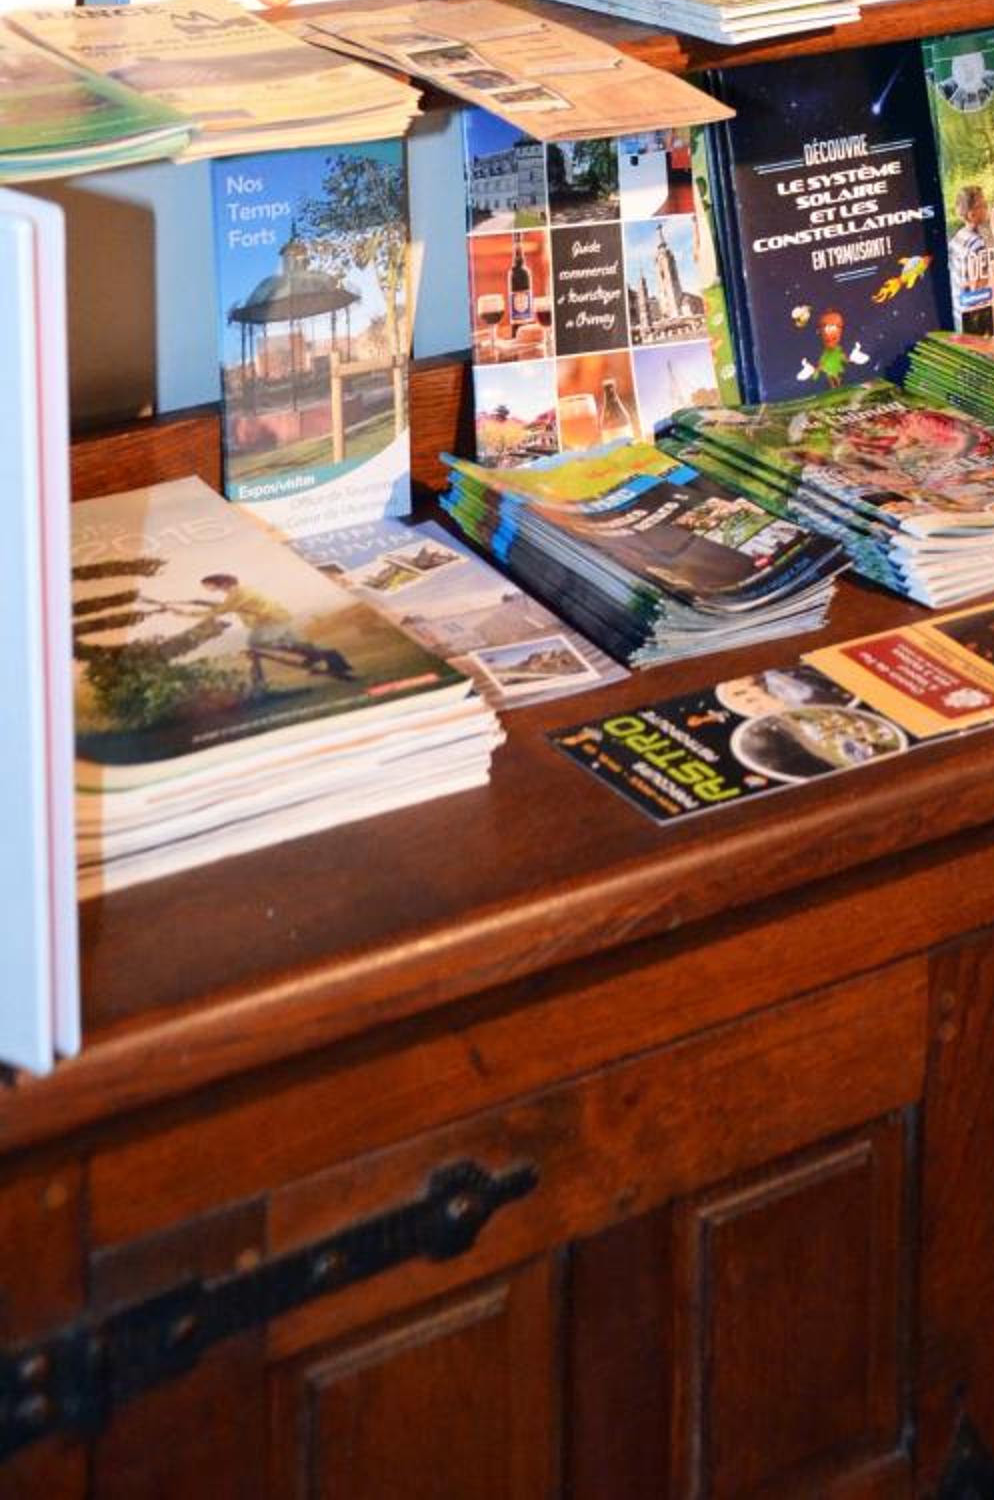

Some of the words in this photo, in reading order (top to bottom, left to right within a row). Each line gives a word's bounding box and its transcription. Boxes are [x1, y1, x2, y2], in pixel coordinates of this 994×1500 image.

[803, 134, 869, 166] DÉCOUVRE
[226, 175, 263, 195] Nos
[777, 179, 805, 196] LE
[806, 161, 903, 192] SYSTÈME
[796, 181, 890, 210] SOLAIRE
[226, 202, 291, 223] Temps
[810, 208, 834, 225] ET
[839, 200, 879, 218] LES
[228, 230, 276, 250] Forts
[753, 205, 936, 253] CONSTELLATIONS
[603, 715, 741, 803] ASTRO
